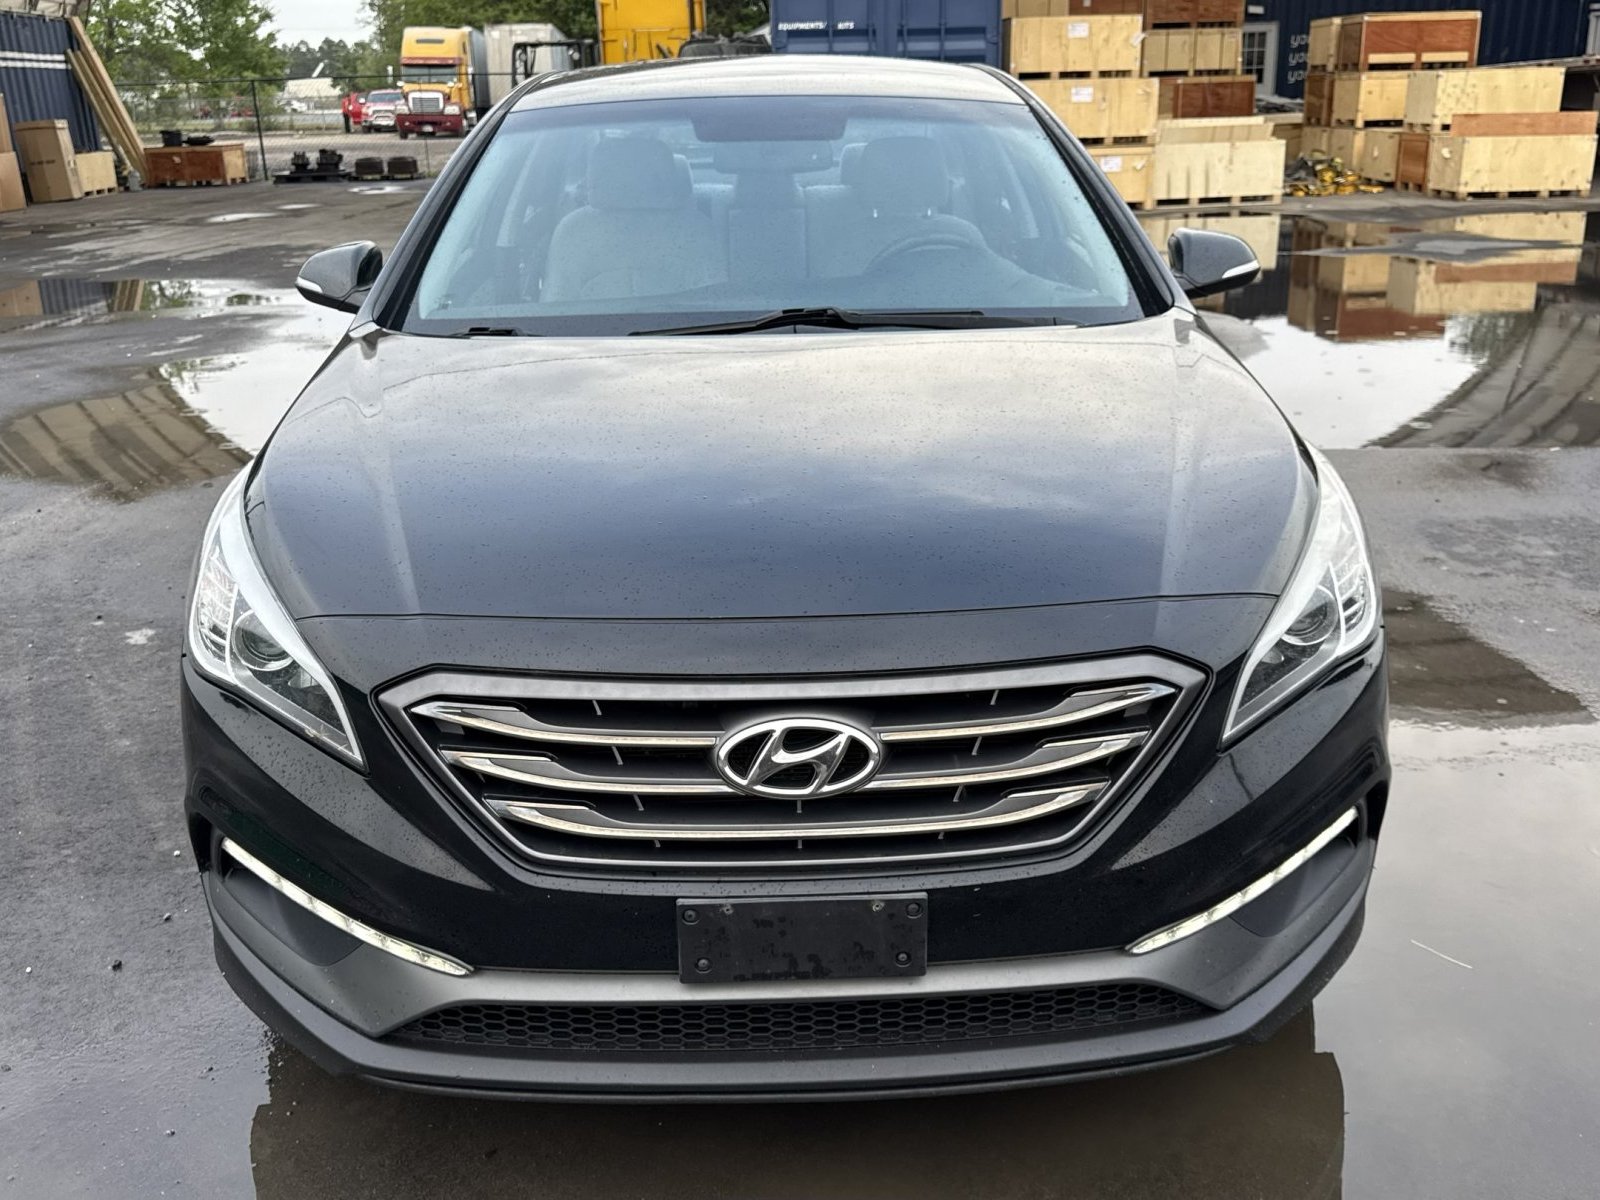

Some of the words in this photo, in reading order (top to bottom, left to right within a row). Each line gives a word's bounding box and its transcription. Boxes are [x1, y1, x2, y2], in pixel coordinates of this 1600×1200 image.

[1290, 34, 1309, 48] yo
[1288, 52, 1308, 66] yo
[1287, 70, 1307, 84] yo
